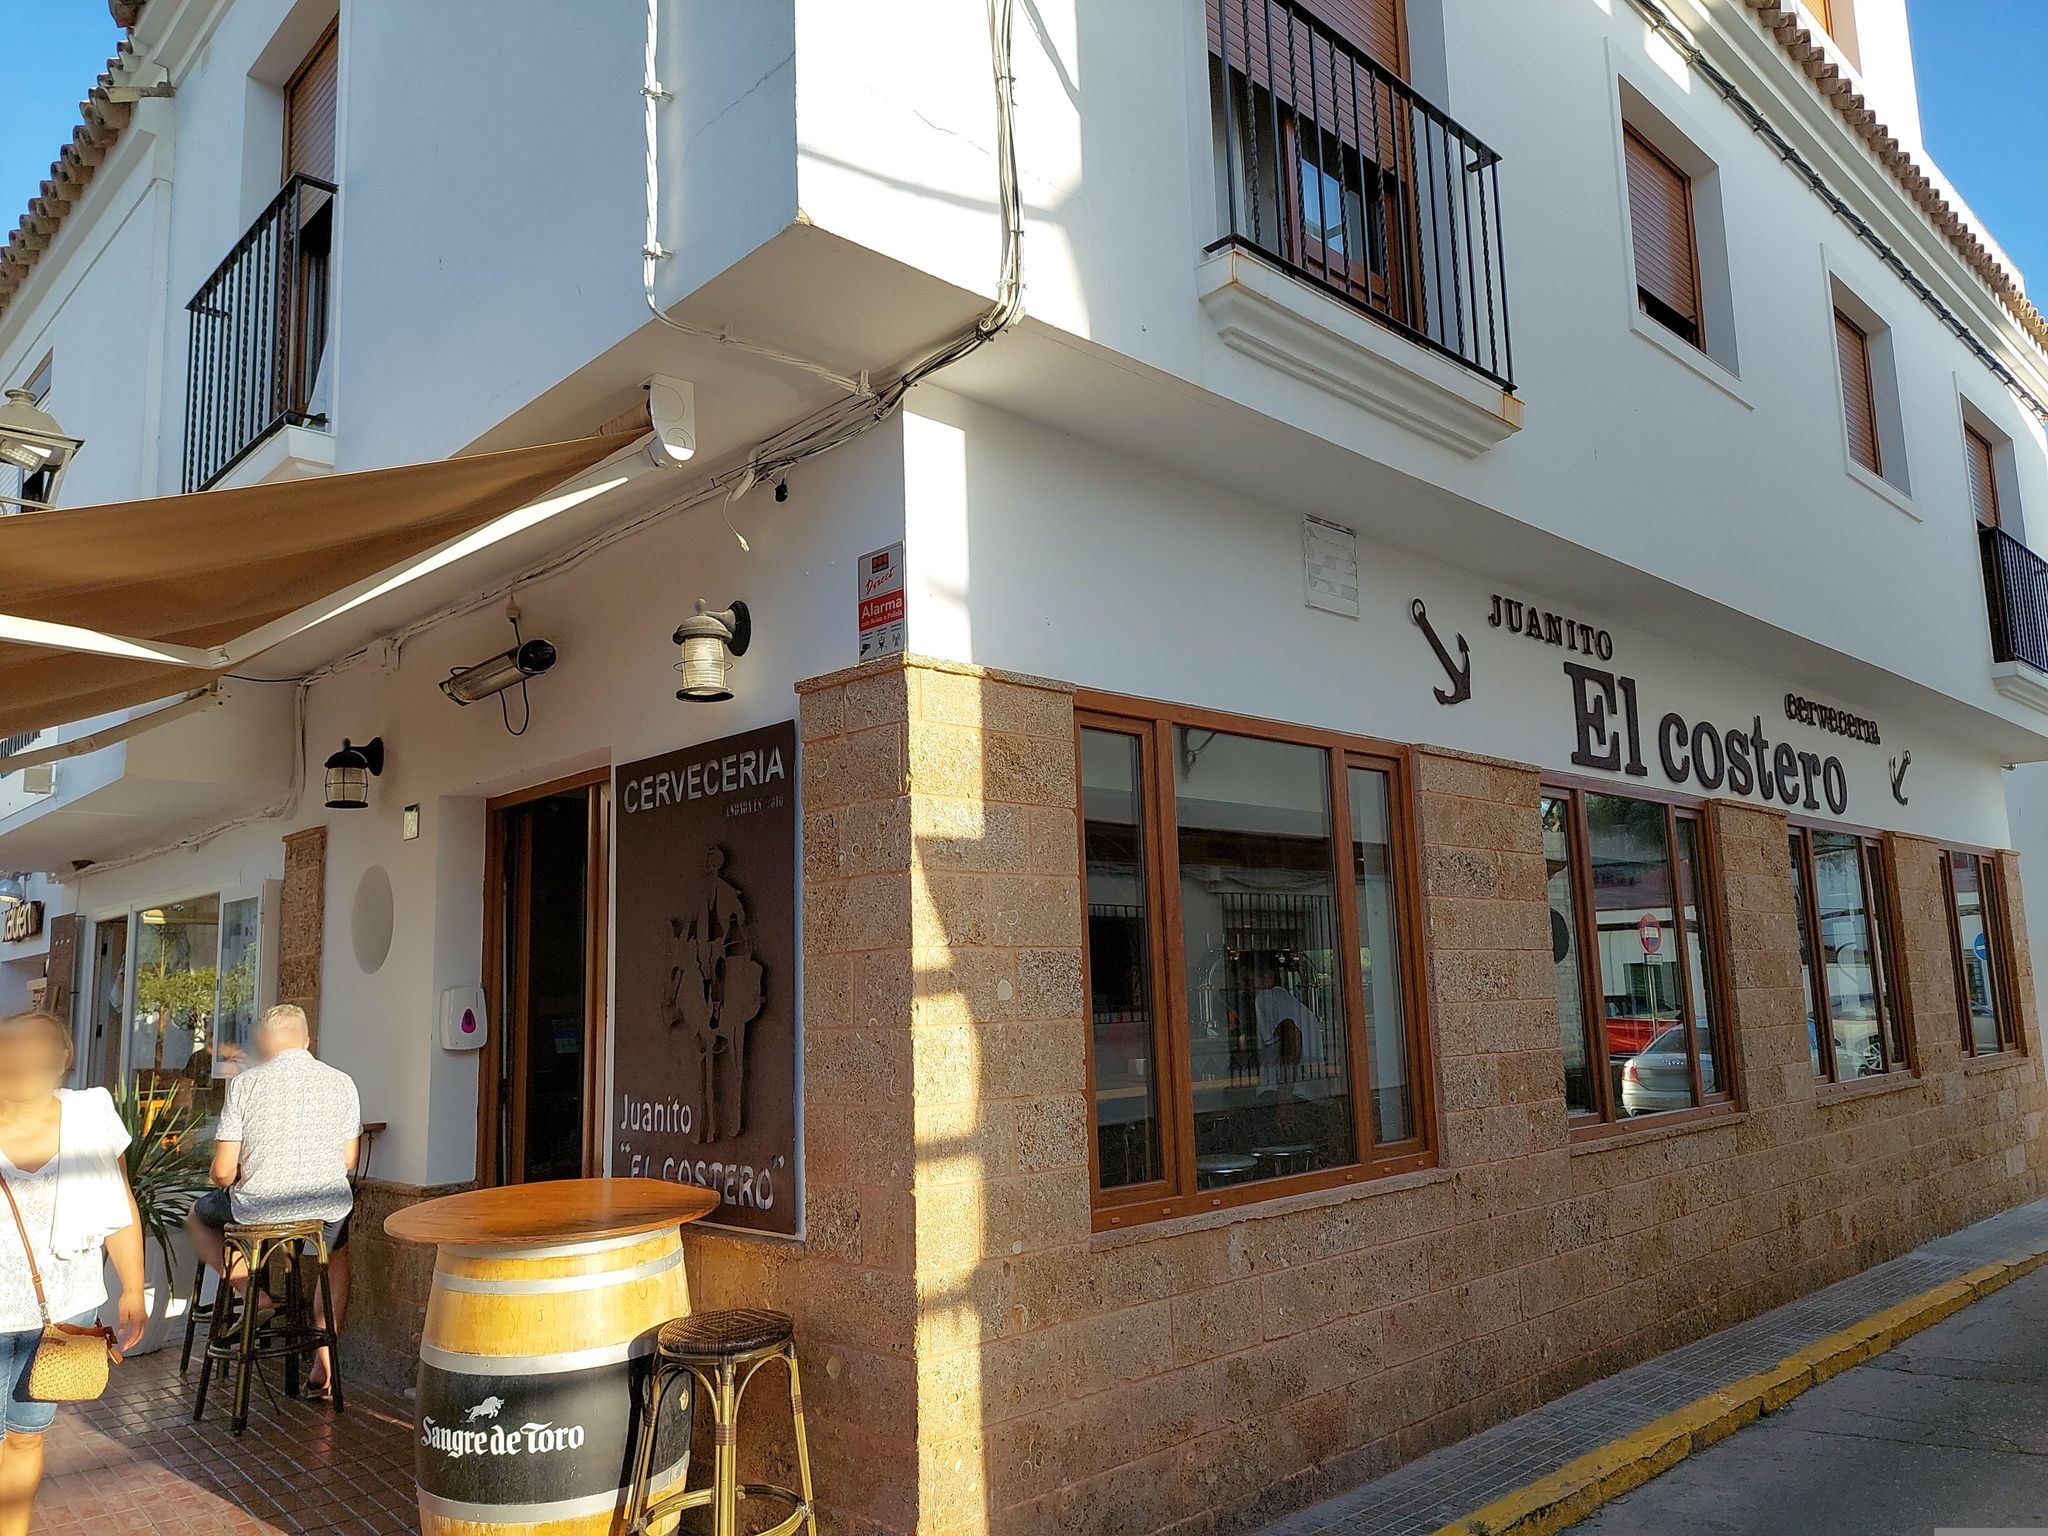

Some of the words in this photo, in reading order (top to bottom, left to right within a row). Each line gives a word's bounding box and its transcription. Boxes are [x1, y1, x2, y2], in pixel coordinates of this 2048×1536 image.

[865, 564, 898, 596] Direct
[861, 597, 903, 620] Alarma
[1488, 594, 1614, 661] JUANITO
[1563, 661, 1648, 777] El
[1658, 712, 1847, 815] costero
[623, 743, 786, 814] CERVECERIA
[620, 1093, 692, 1135] Juanito
[420, 1415, 488, 1459] Sangre
[490, 1425, 524, 1455] de
[520, 1420, 585, 1454] Toro
